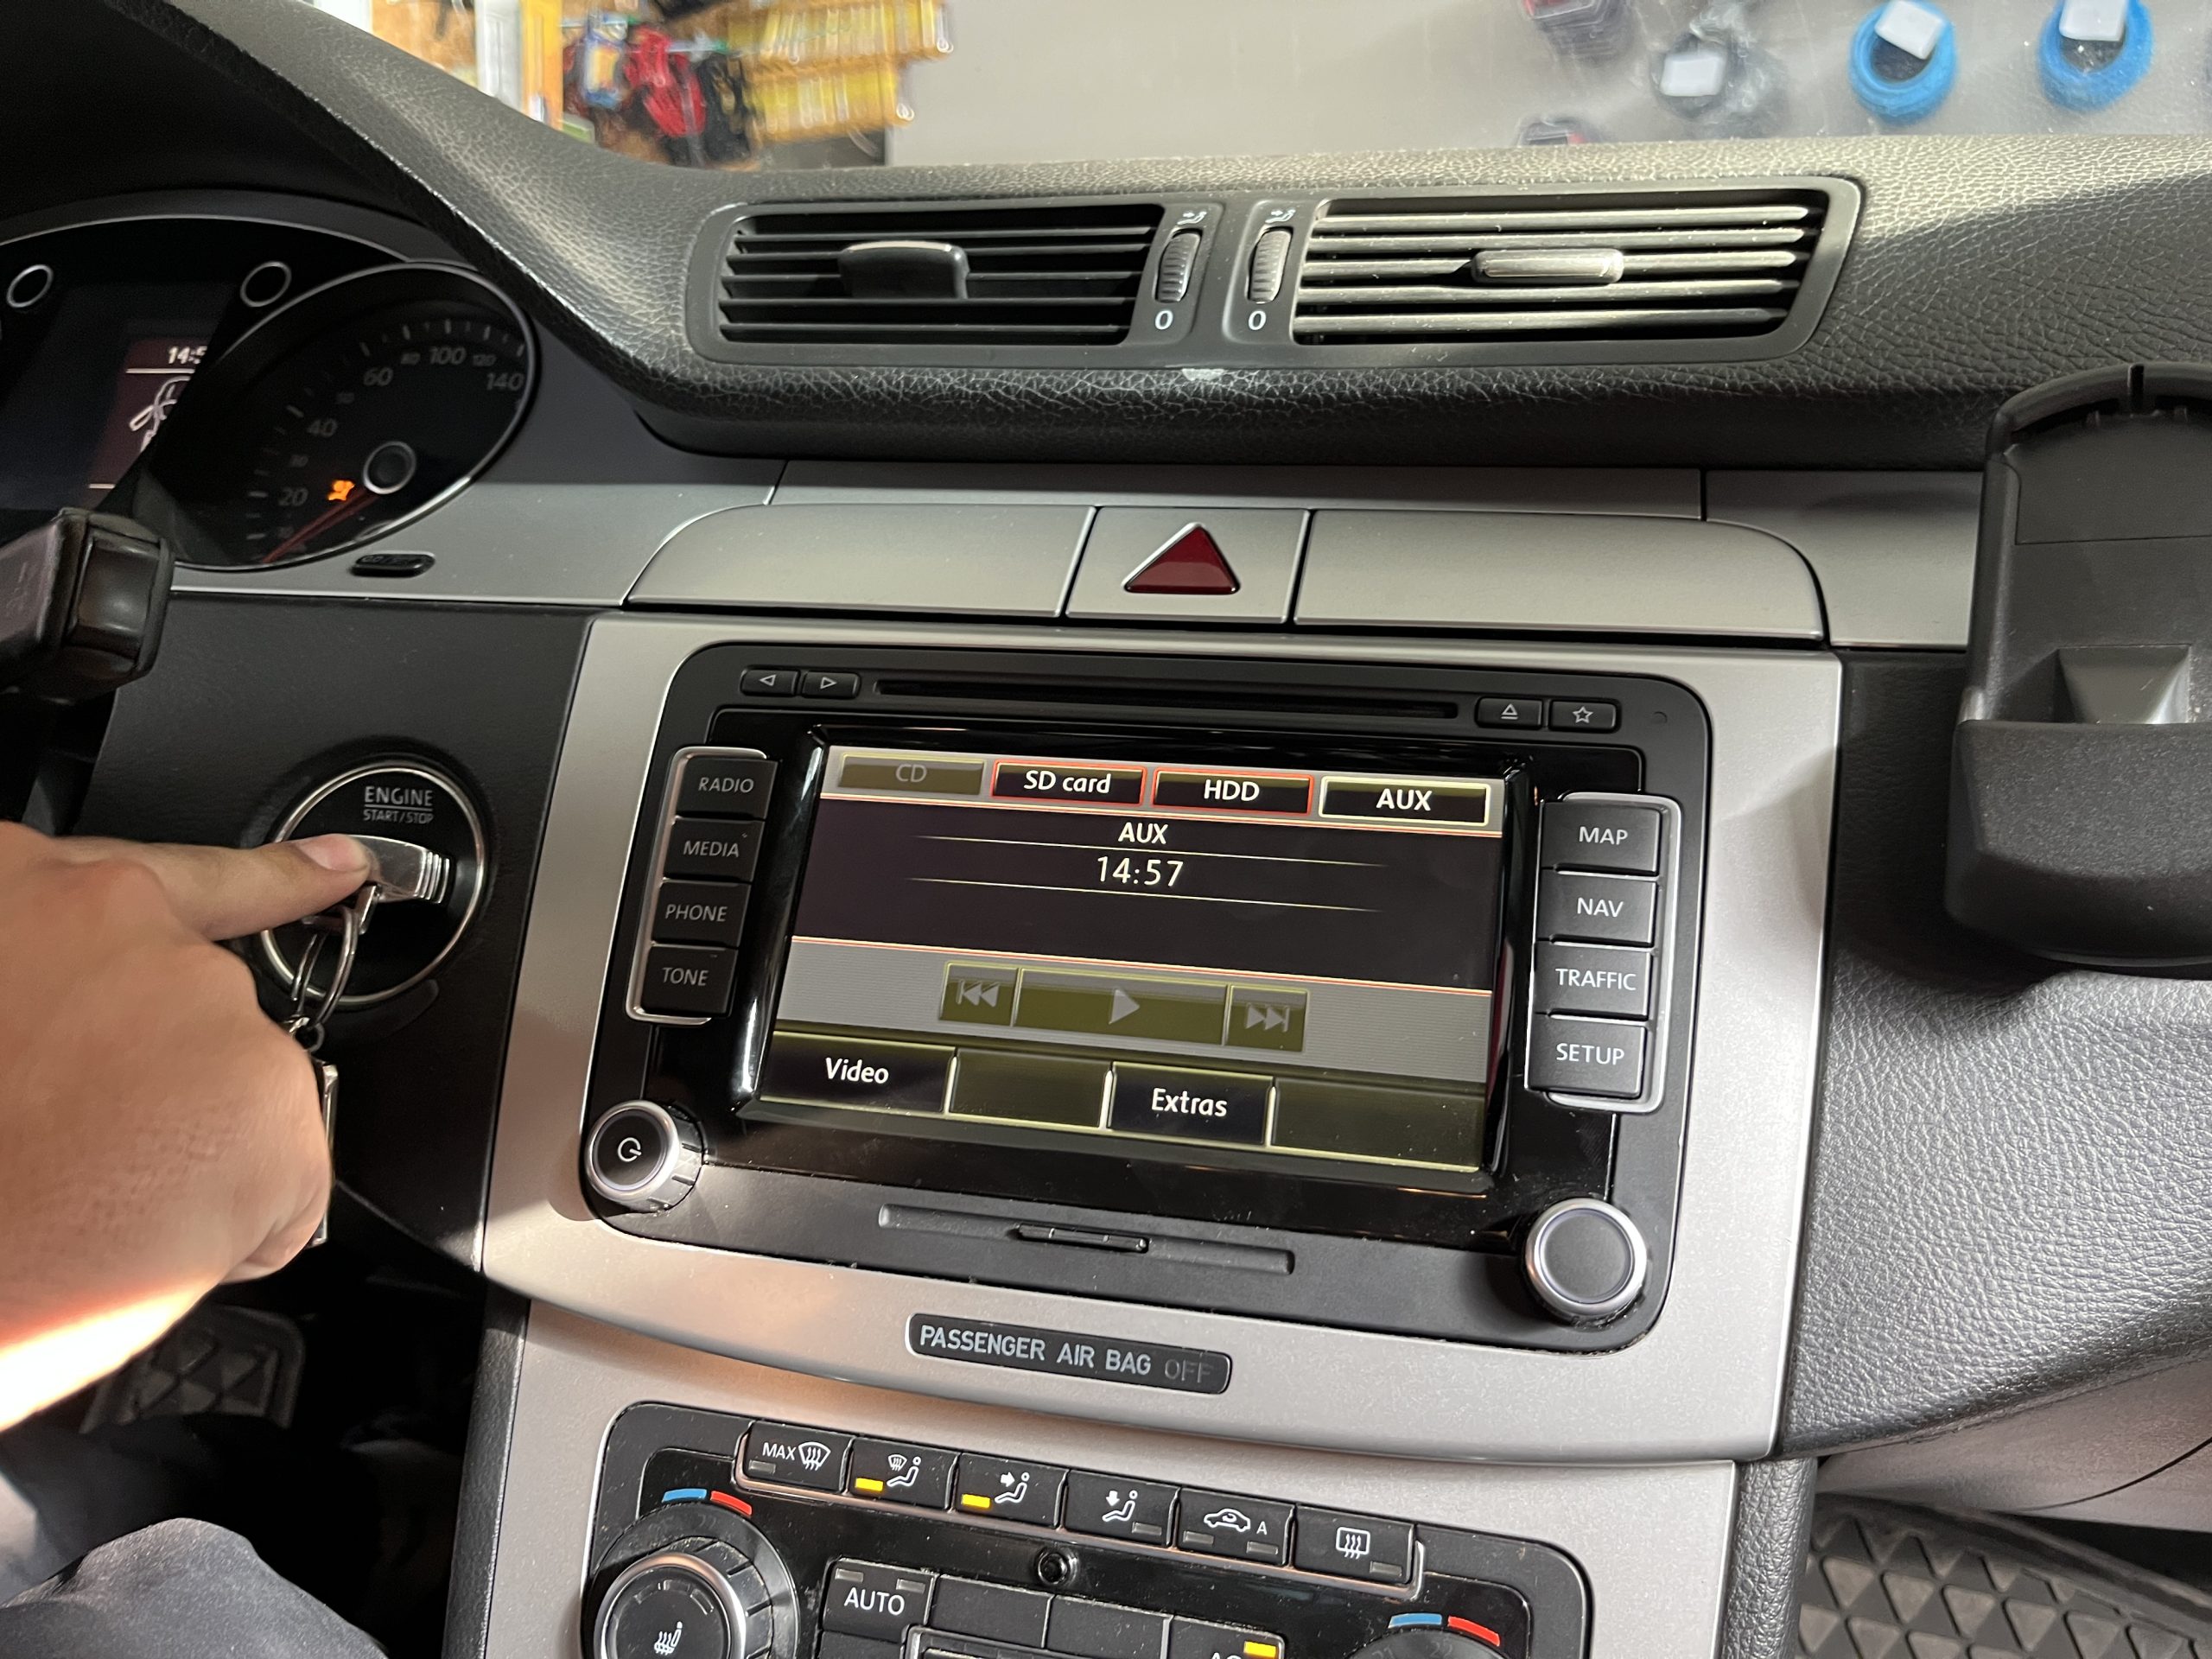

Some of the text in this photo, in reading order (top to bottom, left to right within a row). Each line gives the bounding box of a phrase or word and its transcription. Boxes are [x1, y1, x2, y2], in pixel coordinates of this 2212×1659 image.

[168, 346, 208, 364] 14:5
[429, 346, 467, 365] 100
[363, 366, 394, 387] 60
[486, 372, 525, 391] 140
[307, 418, 339, 438] 40
[277, 486, 309, 507] 20
[895, 763, 928, 783] CD
[1023, 770, 1112, 794] SD card
[364, 785, 434, 806] ENGINE
[697, 777, 754, 794] RADIO
[1204, 779, 1261, 802] HDD
[1376, 788, 1433, 812] AUX
[363, 809, 435, 824] START/STOP
[1117, 822, 1169, 845] AUX
[1578, 825, 1629, 846] MAP
[683, 840, 740, 858] MEDIA
[1096, 855, 1184, 887] 14:57
[664, 904, 728, 923] PHONE
[1576, 897, 1624, 918] NAV
[662, 966, 709, 987] TONE
[1555, 968, 1637, 991] TRAFFIC
[1555, 1042, 1625, 1065] SETUP
[825, 1057, 890, 1086] Video
[1151, 1087, 1229, 1119] Extras
[919, 1325, 1214, 1383] PASSENGER AIR BAG OFF
[762, 1442, 797, 1461] MAX
[1255, 1522, 1268, 1535] A
[843, 1586, 906, 1616] AUTO
